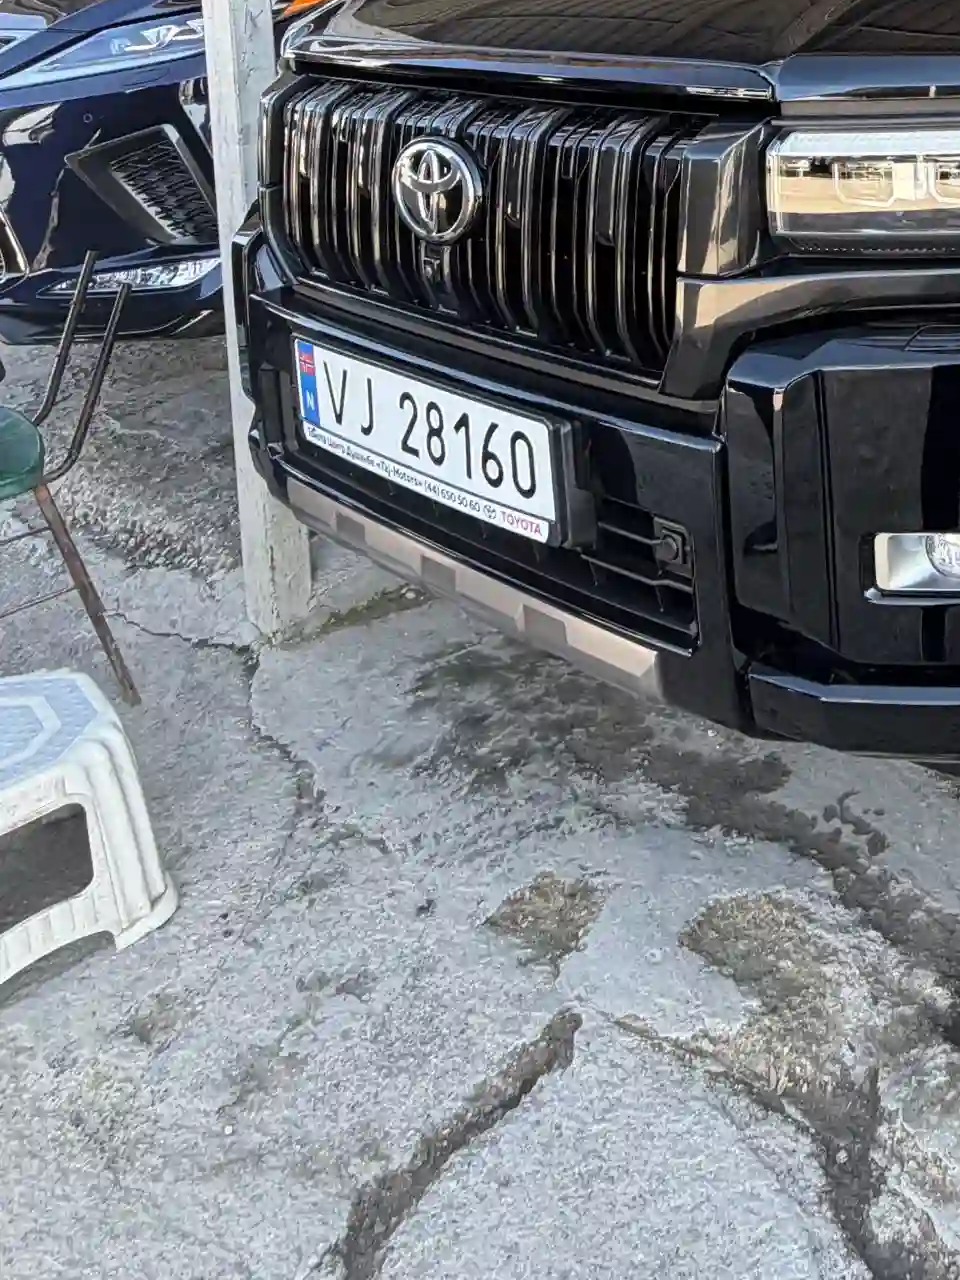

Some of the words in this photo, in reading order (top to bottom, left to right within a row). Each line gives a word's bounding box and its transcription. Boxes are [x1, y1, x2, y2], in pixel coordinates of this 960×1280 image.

[323, 360, 374, 437] VJ
[399, 391, 537, 500] 28160
[500, 509, 542, 537] TOYOTA
